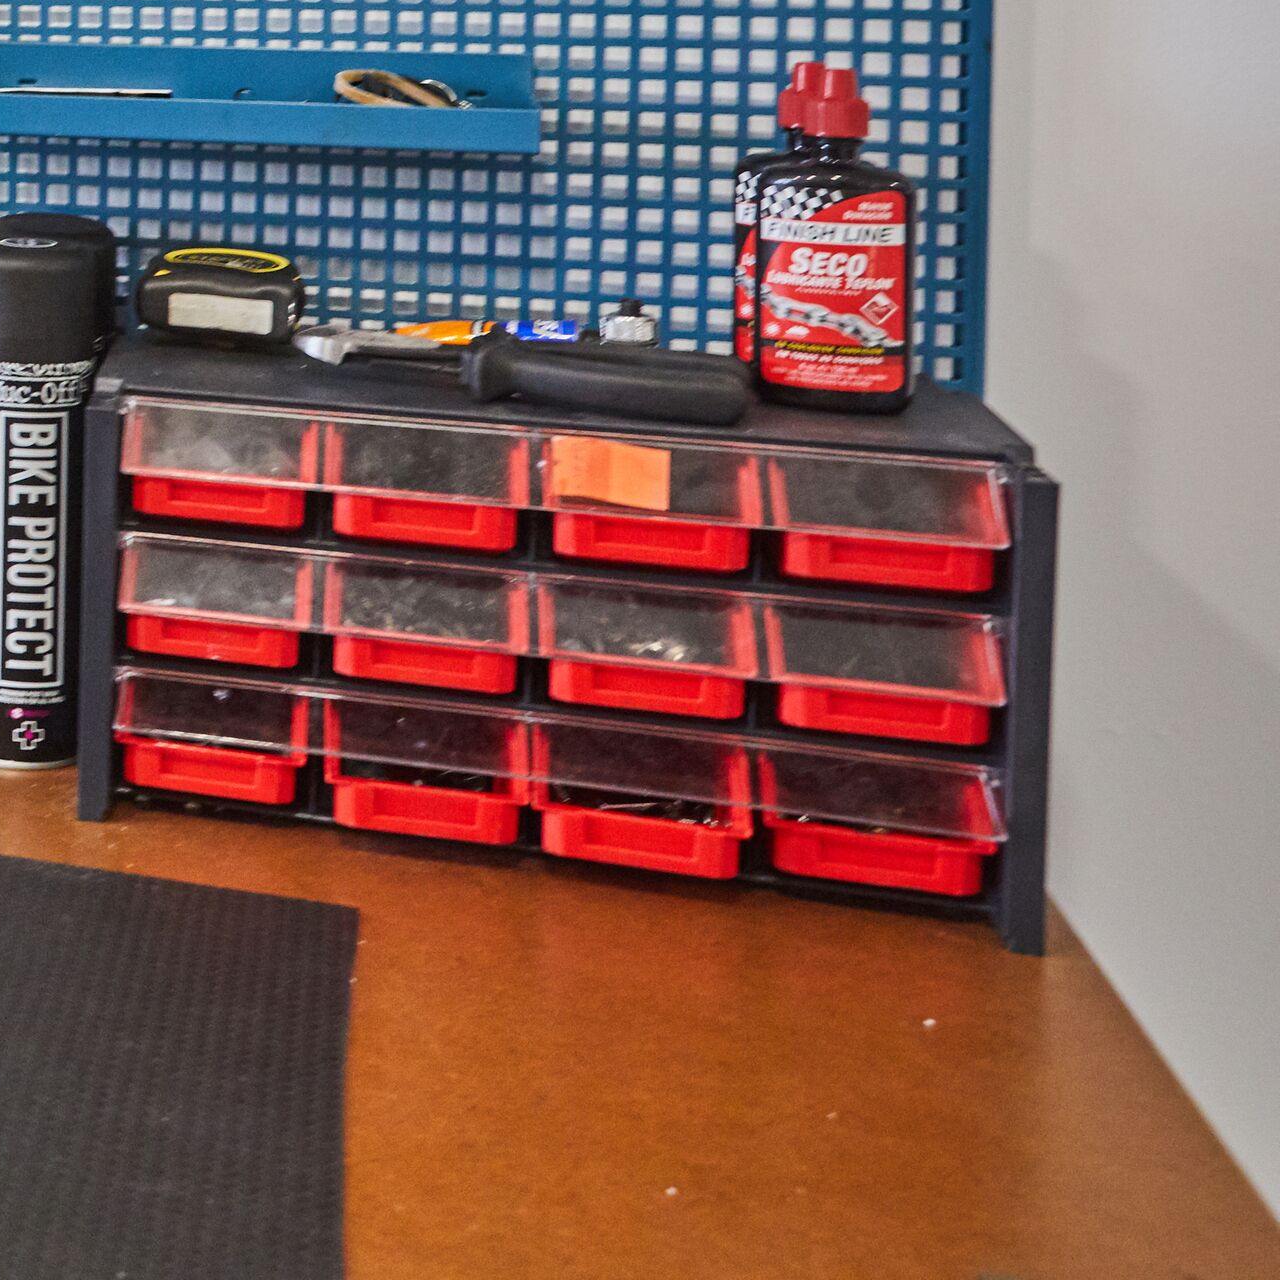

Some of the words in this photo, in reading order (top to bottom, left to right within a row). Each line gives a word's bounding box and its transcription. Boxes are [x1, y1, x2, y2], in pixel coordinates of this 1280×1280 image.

[766, 220, 837, 242] FINISH
[842, 227, 896, 243] LINE
[788, 247, 869, 276] SECO
[7, 422, 58, 506] BIKE
[4, 516, 57, 677] PROTECT
